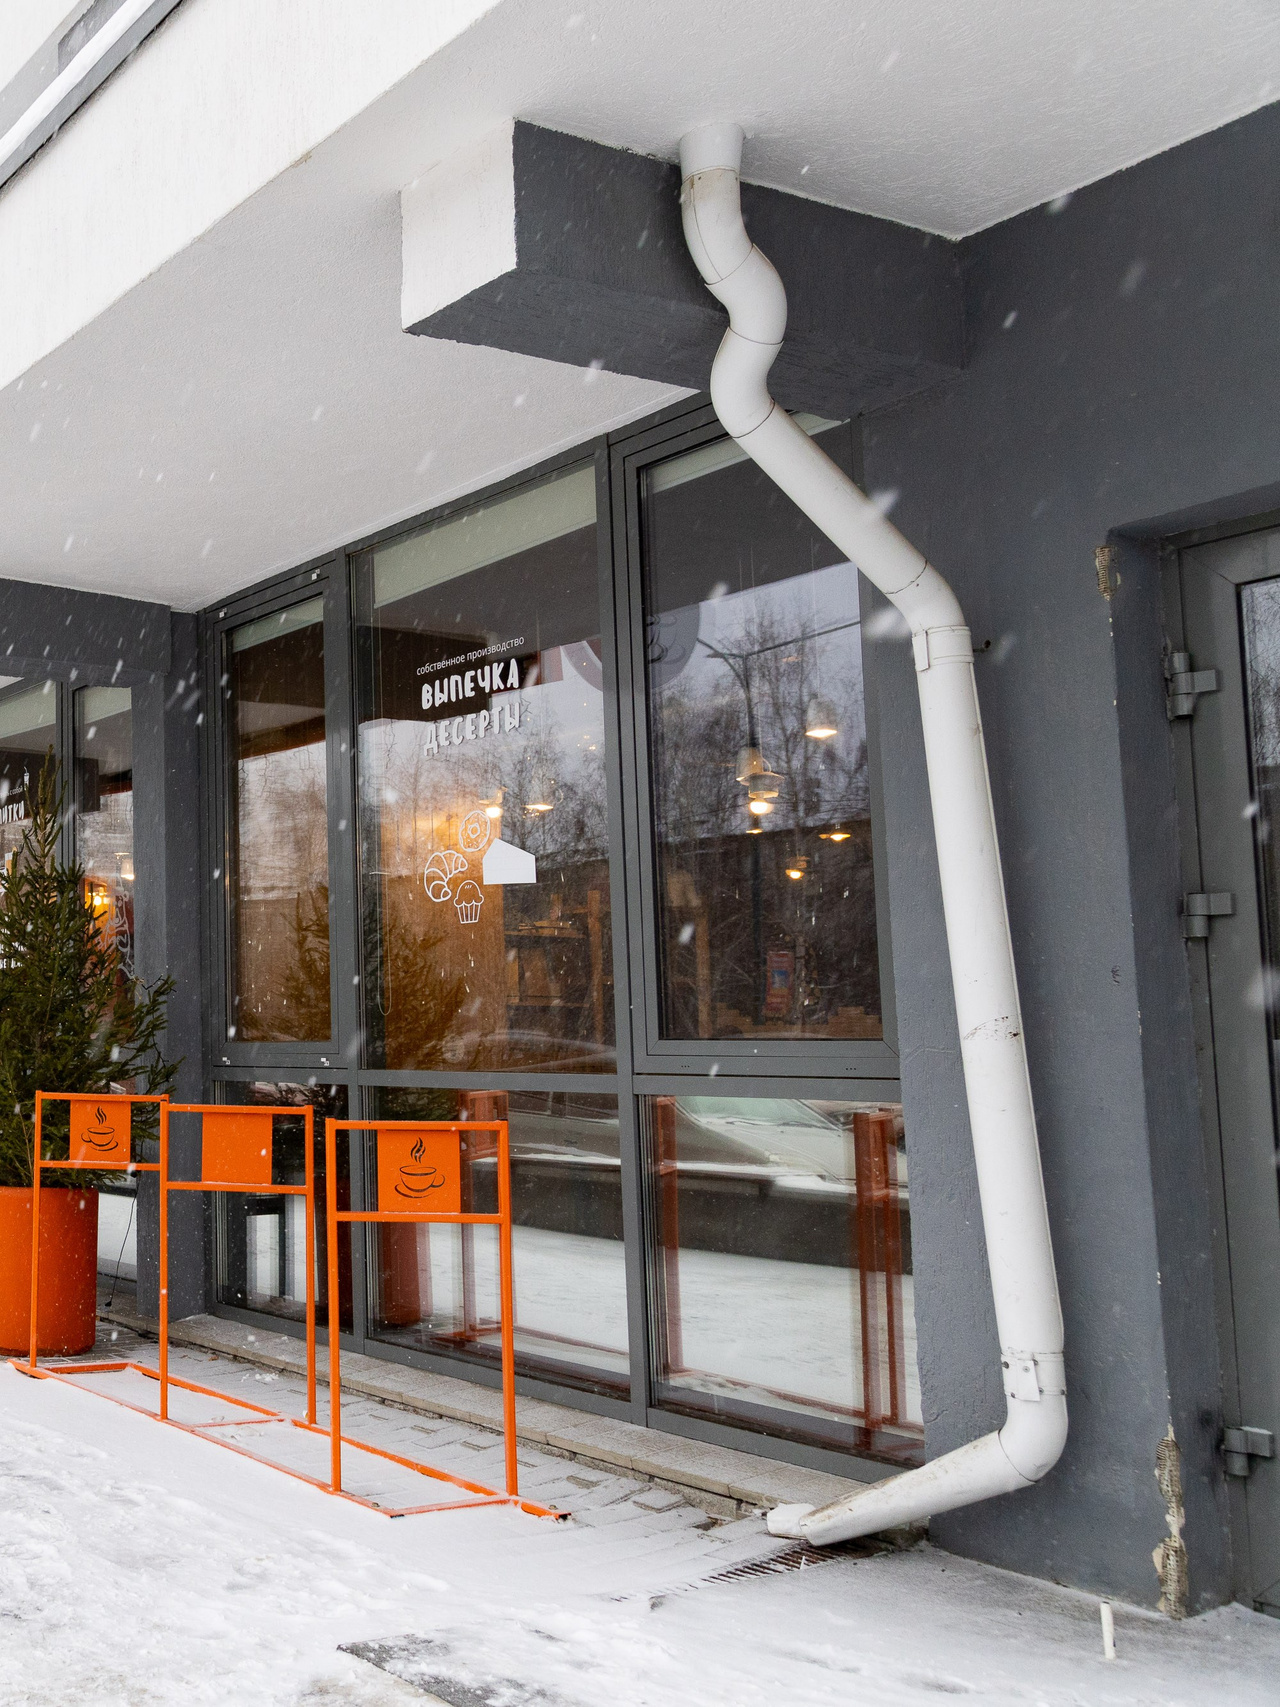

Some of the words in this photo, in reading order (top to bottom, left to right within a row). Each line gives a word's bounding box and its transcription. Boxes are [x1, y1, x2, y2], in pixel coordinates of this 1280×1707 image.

[417, 655, 466, 676] собственное
[467, 636, 524, 663] производство
[421, 658, 519, 710] ВЫПЕЧКА
[424, 702, 520, 756] ДЕСЕРТЫ
